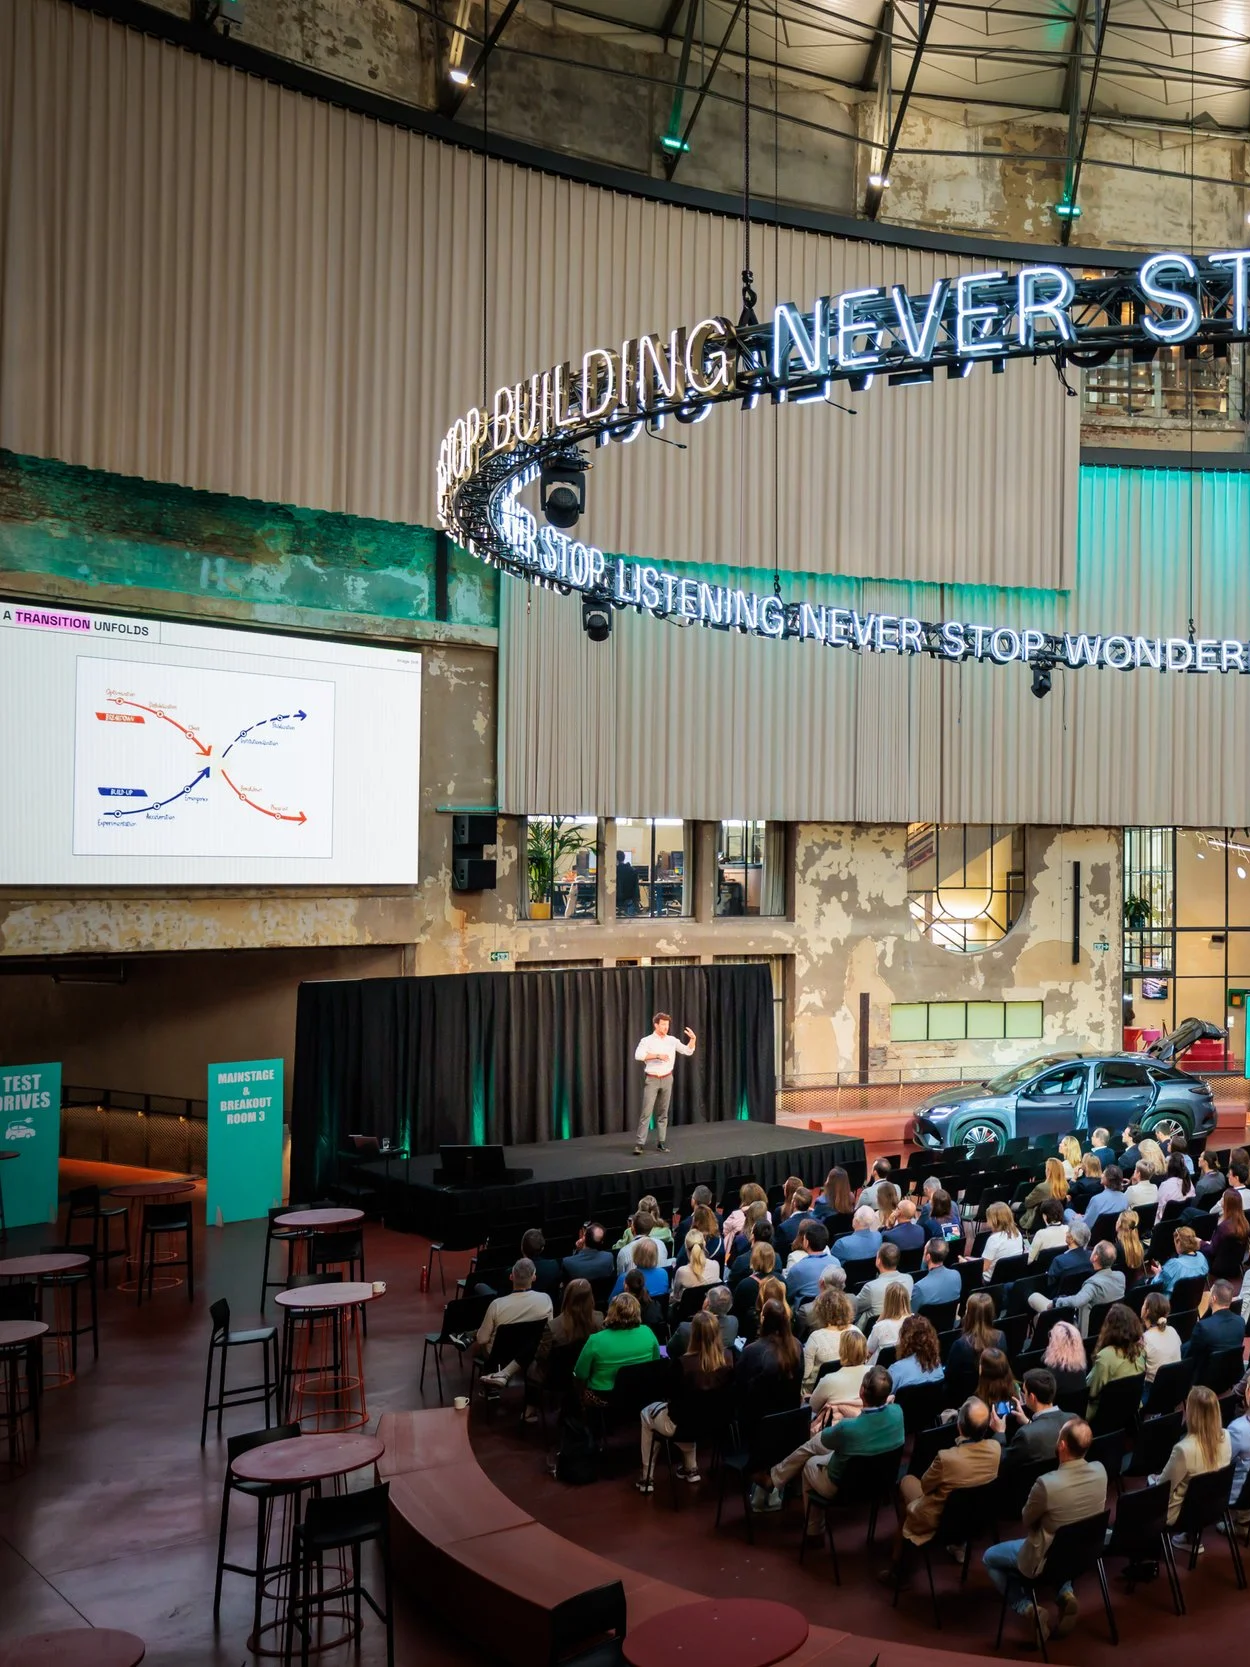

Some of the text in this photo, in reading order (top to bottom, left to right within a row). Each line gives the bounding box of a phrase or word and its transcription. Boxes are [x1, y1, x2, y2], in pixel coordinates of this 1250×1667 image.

[494, 319, 730, 450] BUILDING
[774, 267, 1077, 378] NEVER
[540, 525, 605, 588] STOP
[615, 557, 785, 637] LISTENING
[800, 601, 923, 652] NEVER
[942, 621, 1045, 662] STOP
[3, 610, 149, 636] A TRANSITION UNFOLDS
[3, 1073, 42, 1092] TEST
[218, 1069, 275, 1084] MAINSTAGE
[242, 1087, 250, 1096] &
[220, 1097, 273, 1112] BREAKOUT
[227, 1111, 266, 1125] ROOM 3
